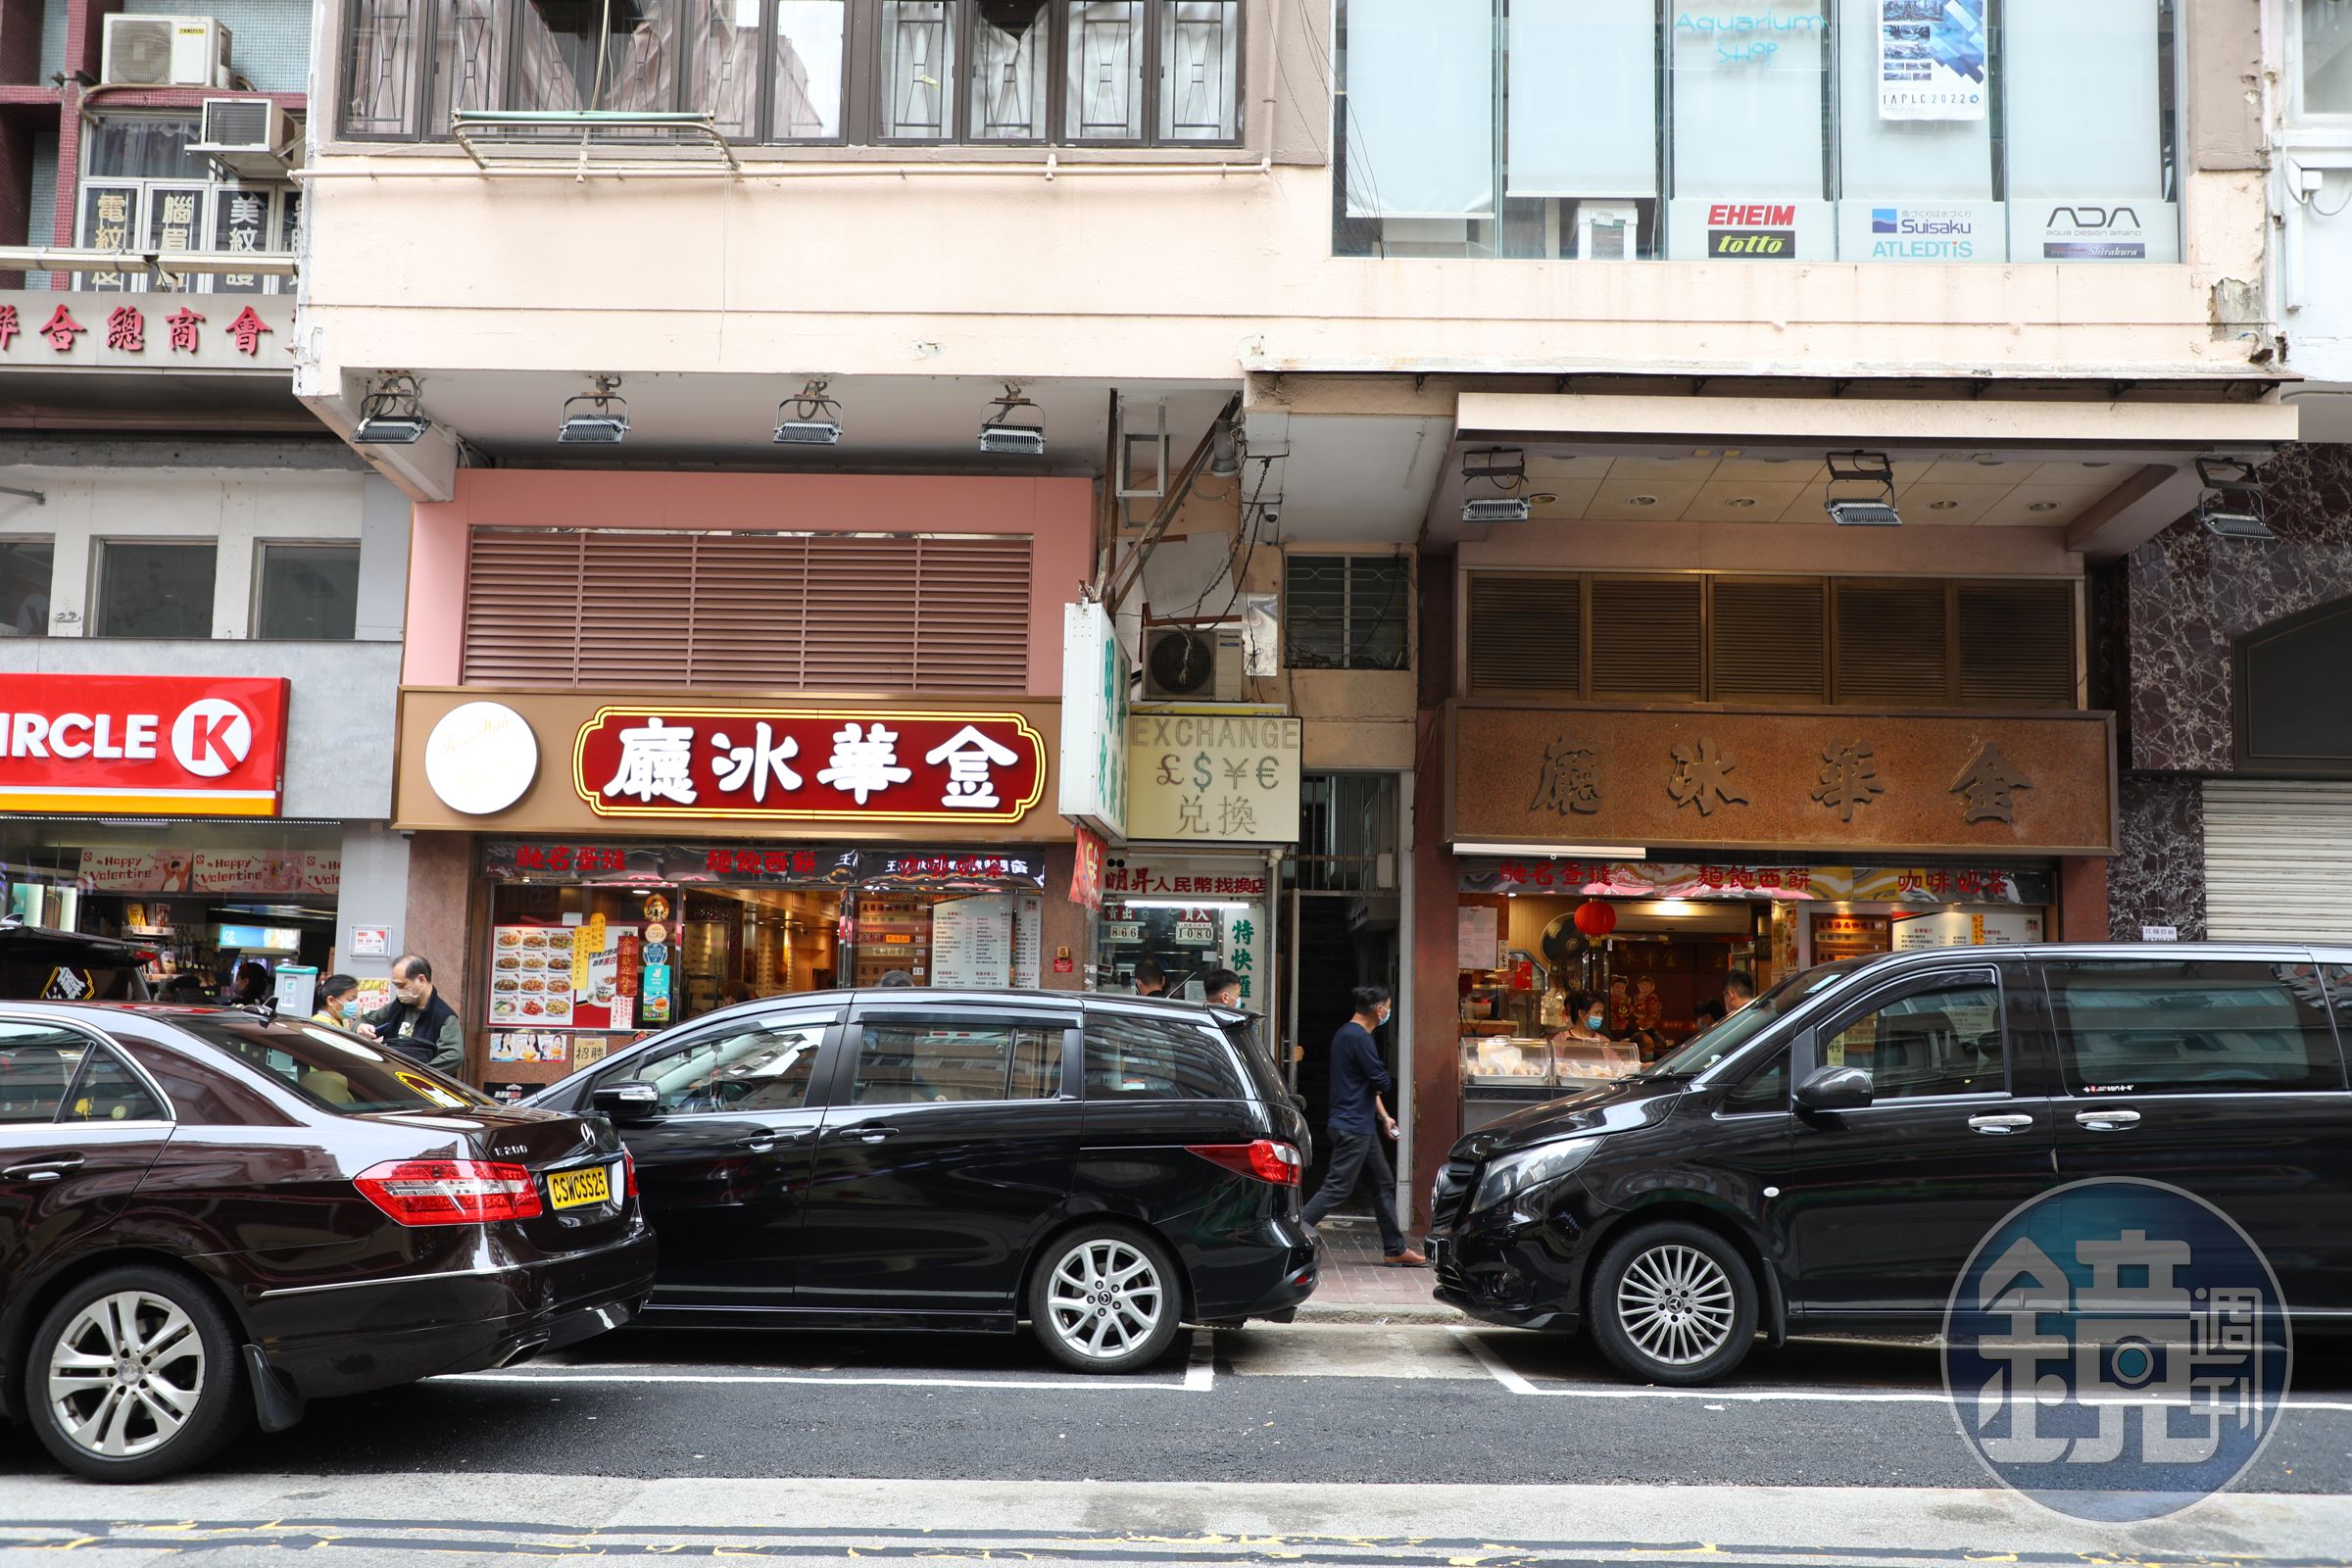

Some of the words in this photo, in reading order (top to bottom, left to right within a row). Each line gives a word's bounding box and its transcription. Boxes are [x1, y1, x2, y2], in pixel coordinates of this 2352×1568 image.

[1674, 9, 1827, 35] Aquarium
[1883, 93, 1927, 105] IAPLC
[1931, 93, 1966, 104] 2022
[1708, 204, 1795, 226] EHEIM
[2046, 207, 2141, 227] ADA
[1901, 219, 1972, 234] Suisaku
[1718, 235, 1786, 254] totto
[1130, 717, 1299, 750] EXCHANGE
[105, 856, 142, 868] Happy
[215, 858, 252, 870] Happy
[90, 866, 152, 881] Valentine
[200, 869, 263, 882] Valentine
[1897, 869, 2009, 895] 咖啡奶茶
[1111, 927, 1137, 938] 866
[1177, 927, 1212, 939] 1080
[575, 1046, 606, 1060] 招聘
[494, 1145, 528, 1156] E200
[552, 1171, 606, 1205] CSWCSS25
